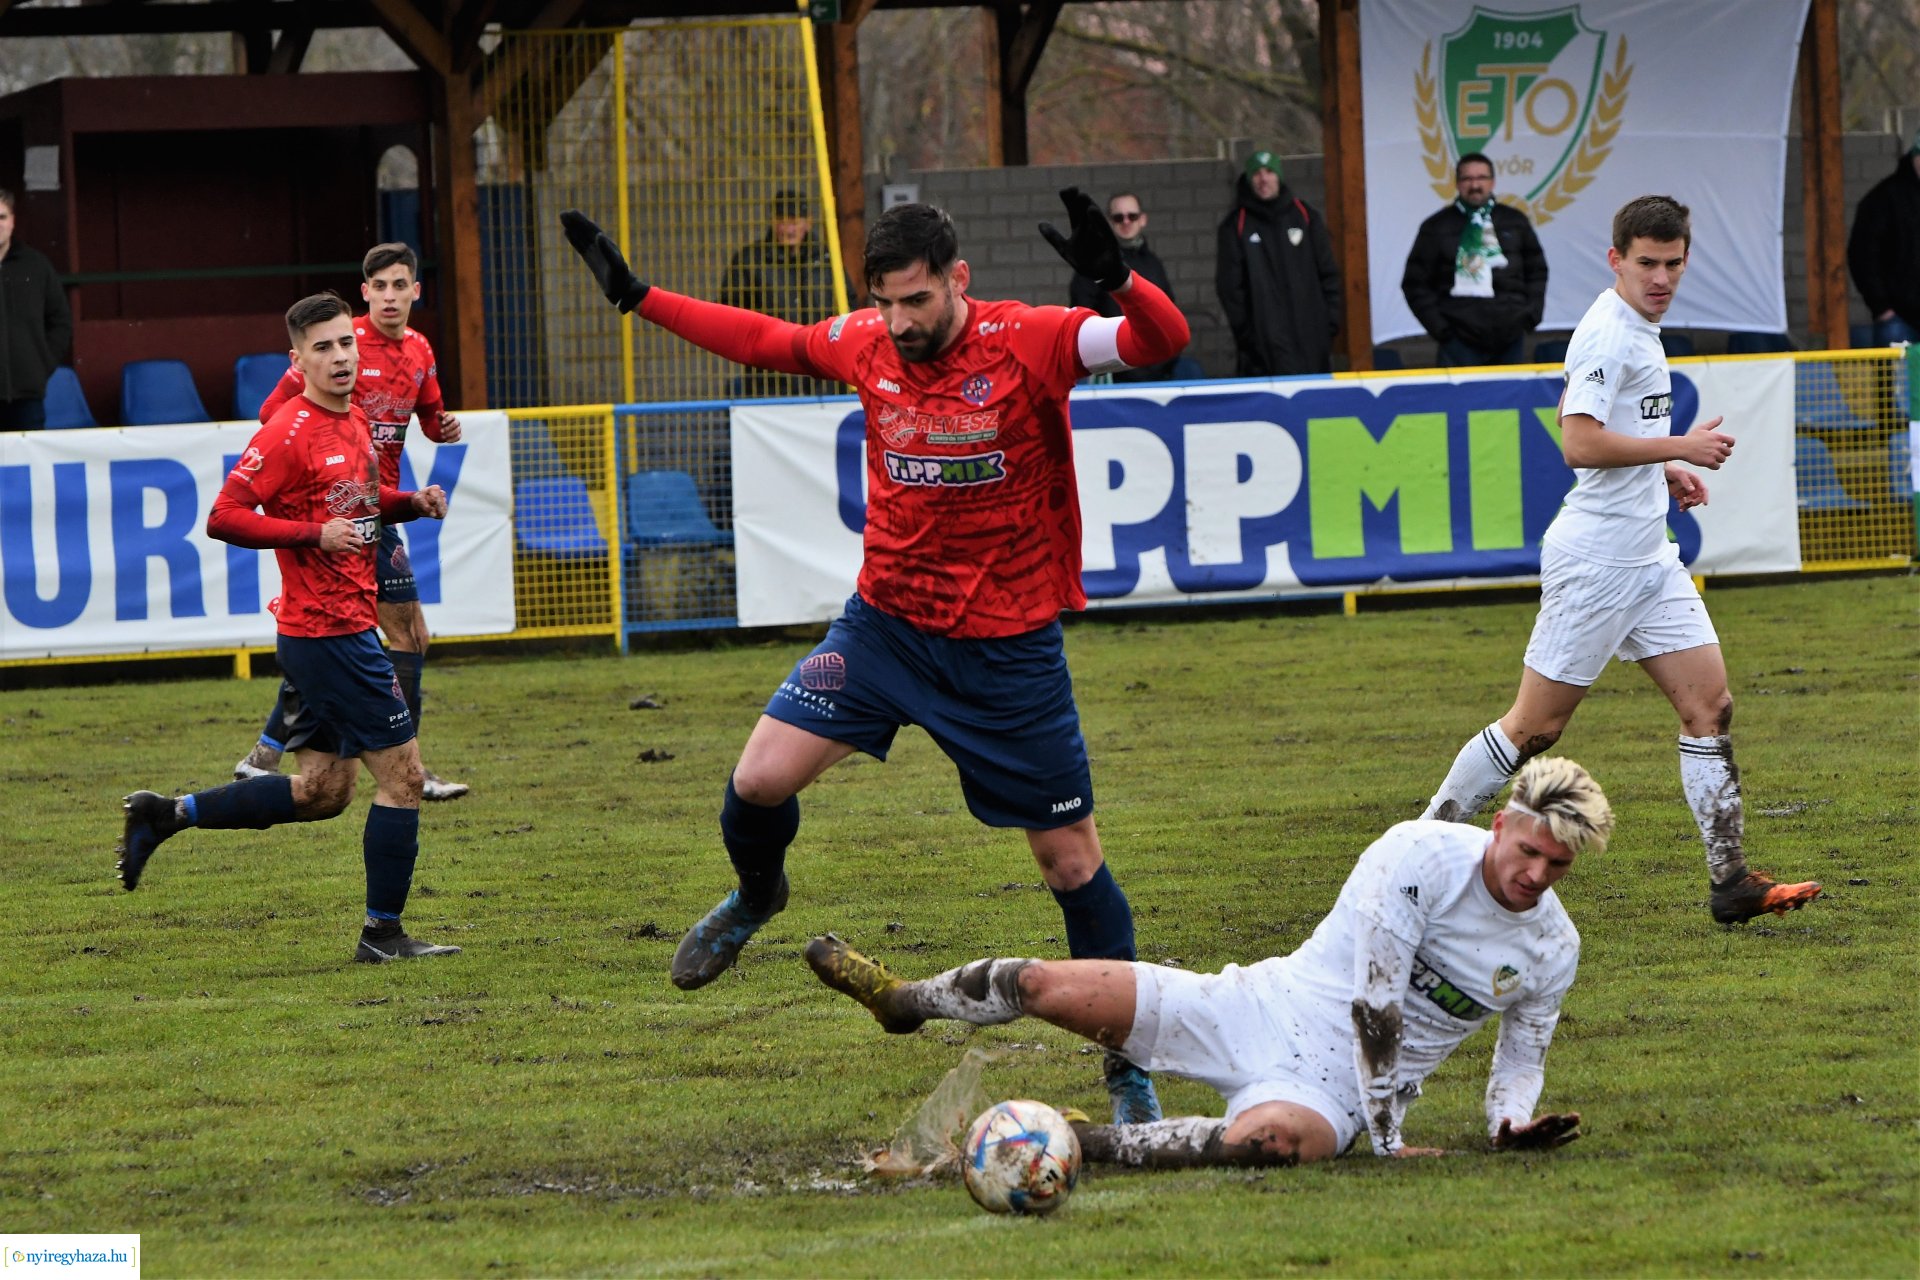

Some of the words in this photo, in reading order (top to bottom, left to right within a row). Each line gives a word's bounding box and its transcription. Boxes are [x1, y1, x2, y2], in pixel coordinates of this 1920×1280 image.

[1493, 31, 1543, 49] 1904
[1457, 63, 1578, 142] ETO
[1495, 155, 1534, 175] YŐR
[361, 368, 381, 377] JAKO
[877, 378, 901, 394] JAKO
[325, 454, 346, 466] JAKO
[0, 444, 468, 628] URIY
[1051, 796, 1082, 814] JAKO
